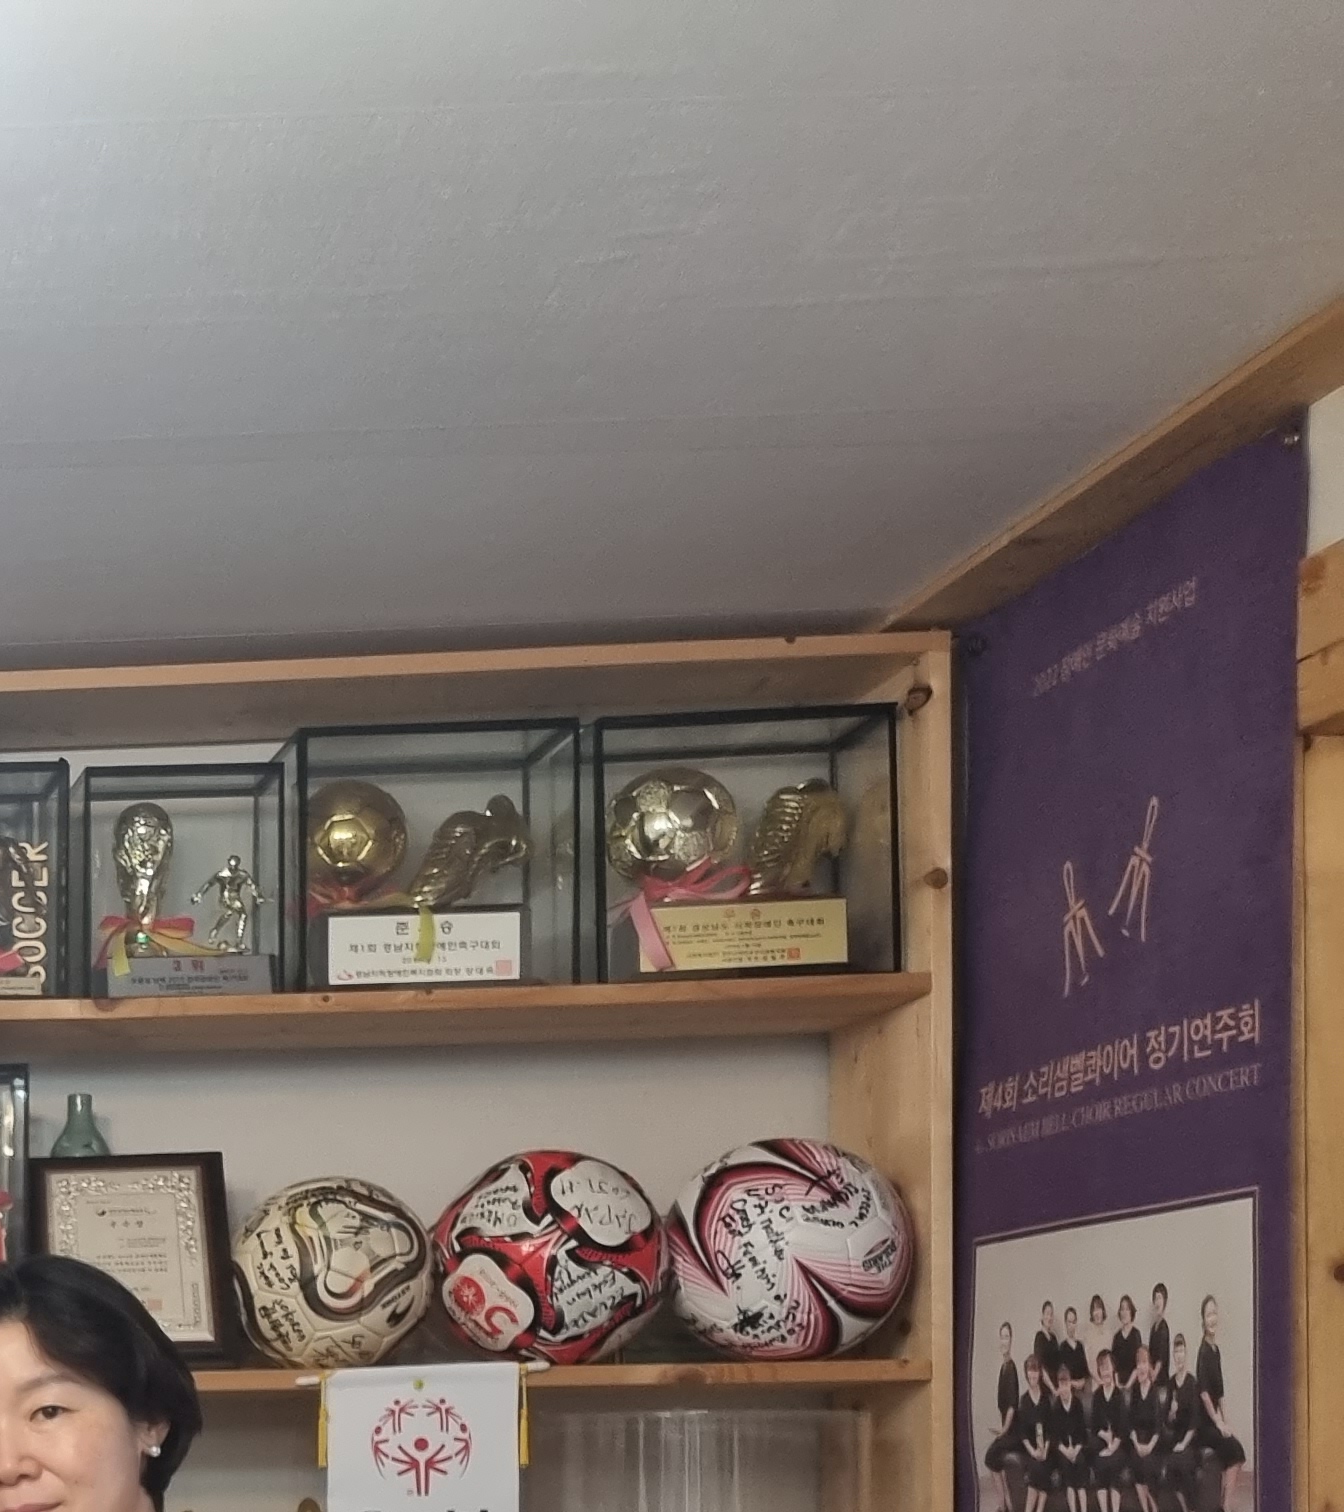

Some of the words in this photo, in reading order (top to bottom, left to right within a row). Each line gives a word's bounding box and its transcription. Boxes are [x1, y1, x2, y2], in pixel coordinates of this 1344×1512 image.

[978, 1072, 1018, 1119] 제4회
[1145, 998, 1261, 1070] 정기연주회
[1071, 1098, 1113, 1132] CHOIR
[1114, 1083, 1185, 1118] REGULAR
[1185, 1063, 1263, 1100] CONCERT
